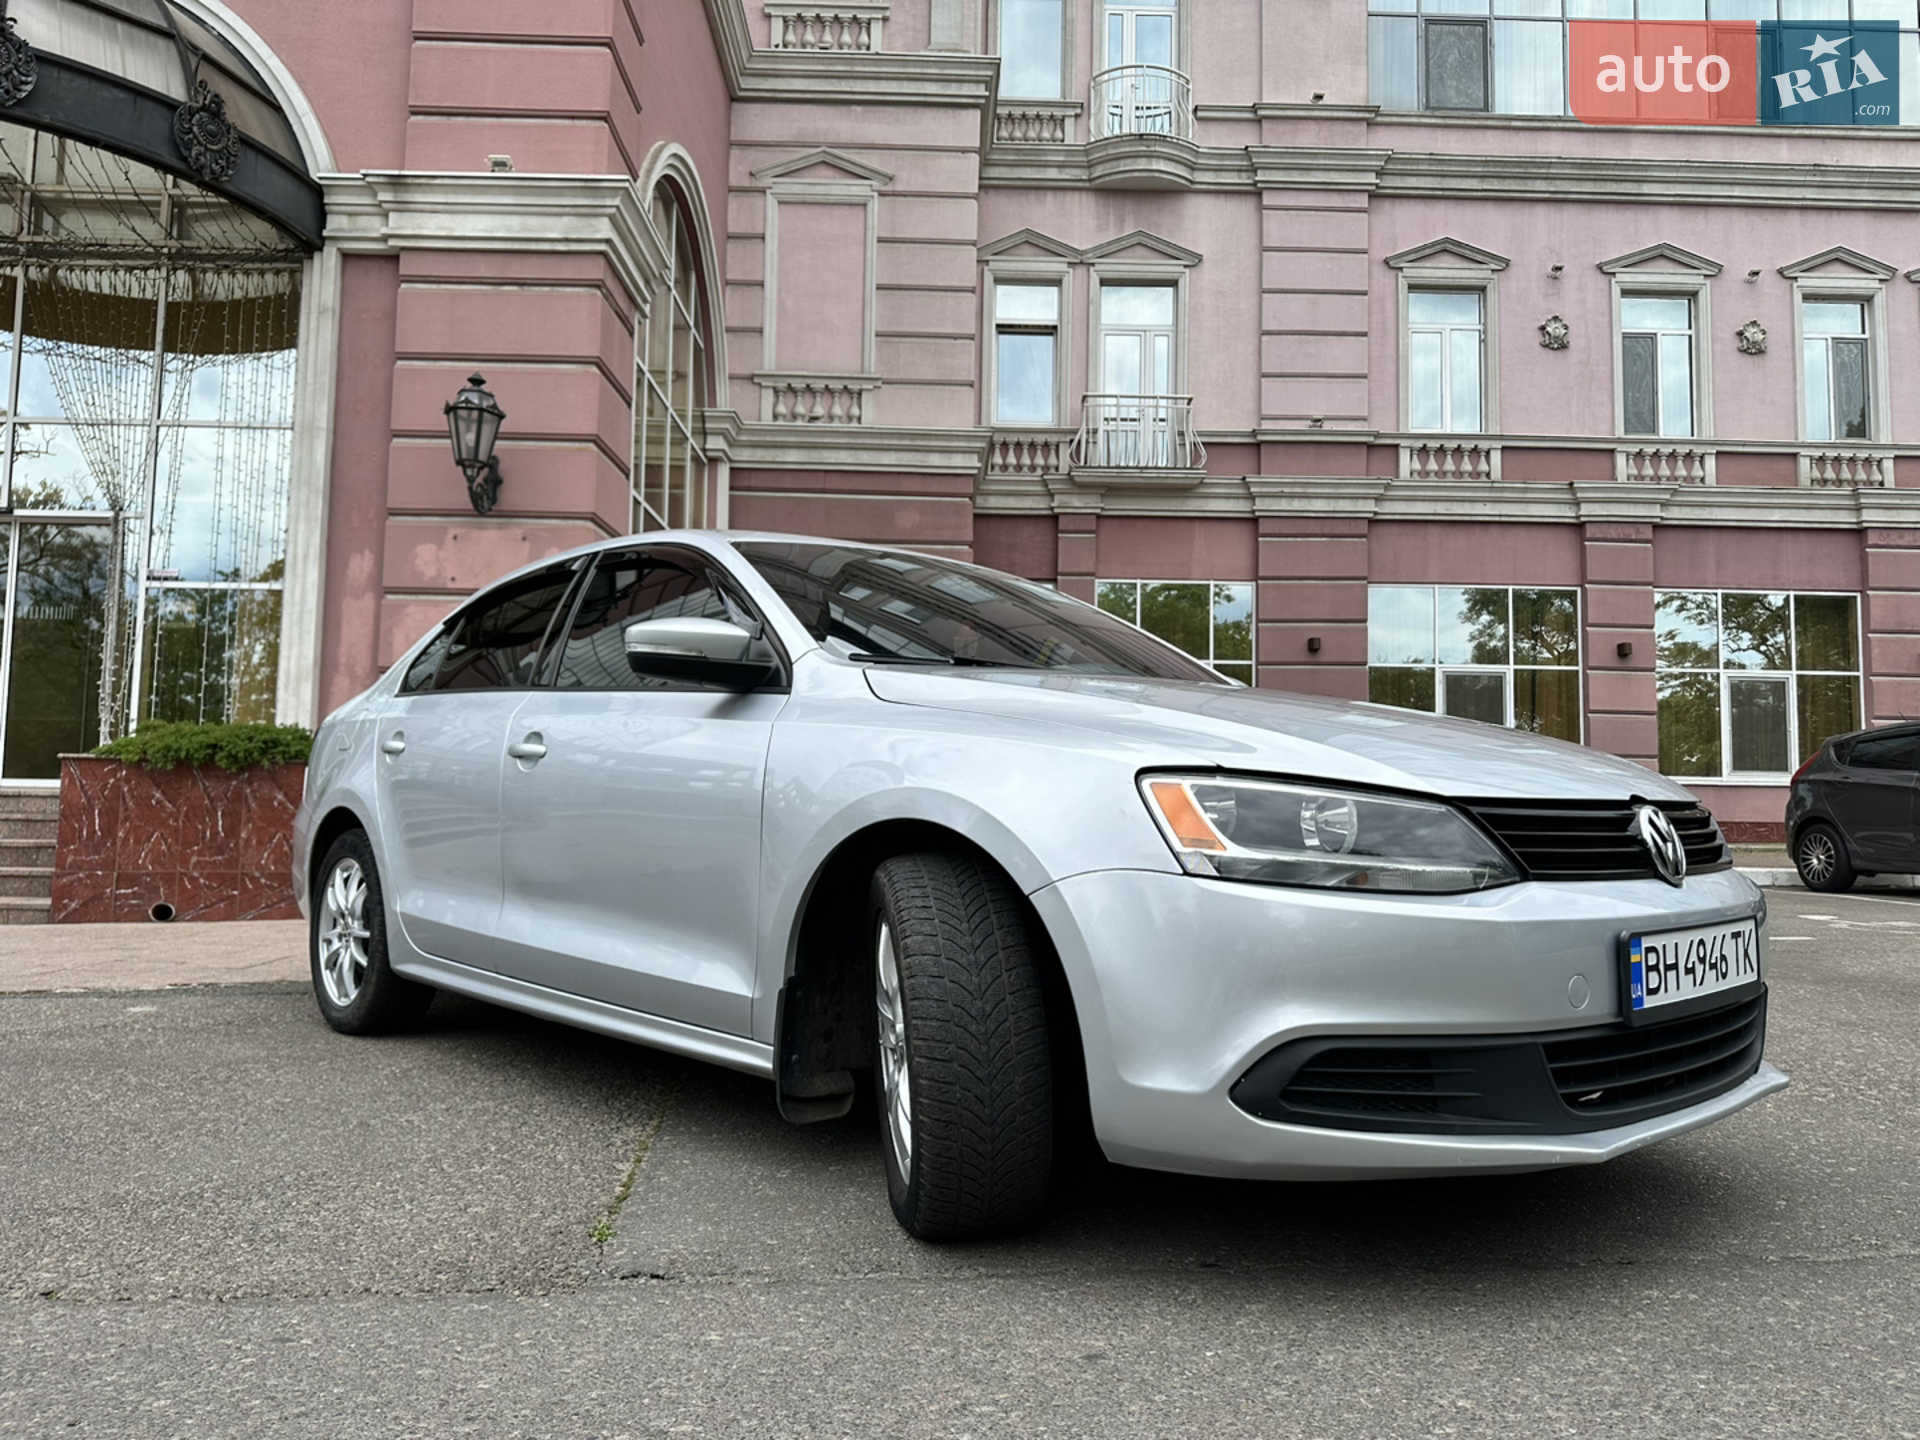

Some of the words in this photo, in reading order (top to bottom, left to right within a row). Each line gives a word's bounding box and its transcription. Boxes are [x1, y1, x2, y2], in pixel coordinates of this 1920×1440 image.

[1644, 941, 1680, 996] BH
[1684, 933, 1728, 987] 4946
[1731, 928, 1755, 977] TK
[1631, 983, 1642, 998] UA
